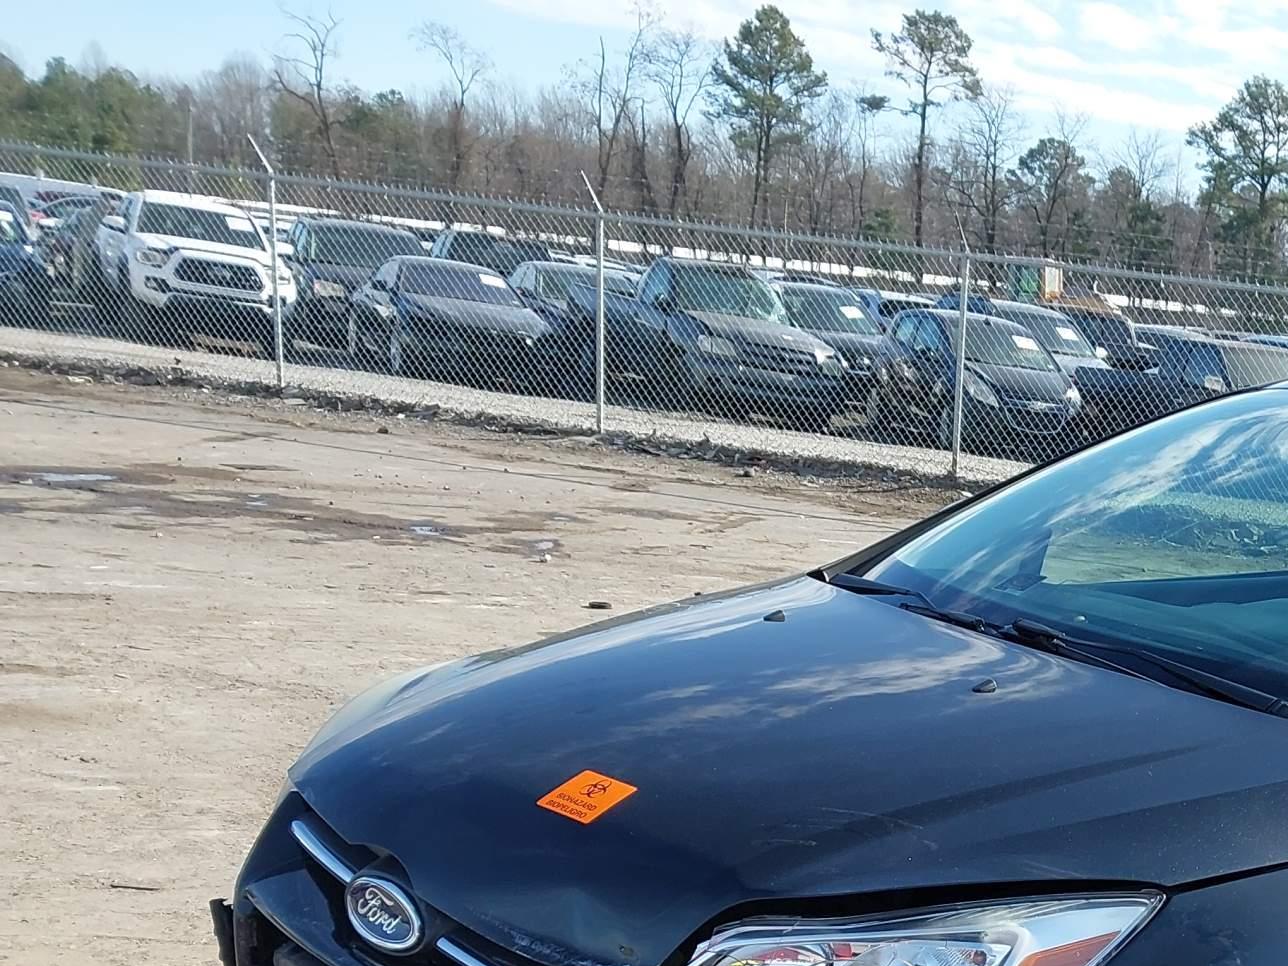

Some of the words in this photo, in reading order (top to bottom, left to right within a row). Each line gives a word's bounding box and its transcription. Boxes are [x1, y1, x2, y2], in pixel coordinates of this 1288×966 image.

[546, 799, 588, 819] BIOPELIGRO
[556, 792, 598, 811] BIOHAZARD
[357, 887, 402, 934] Ford
